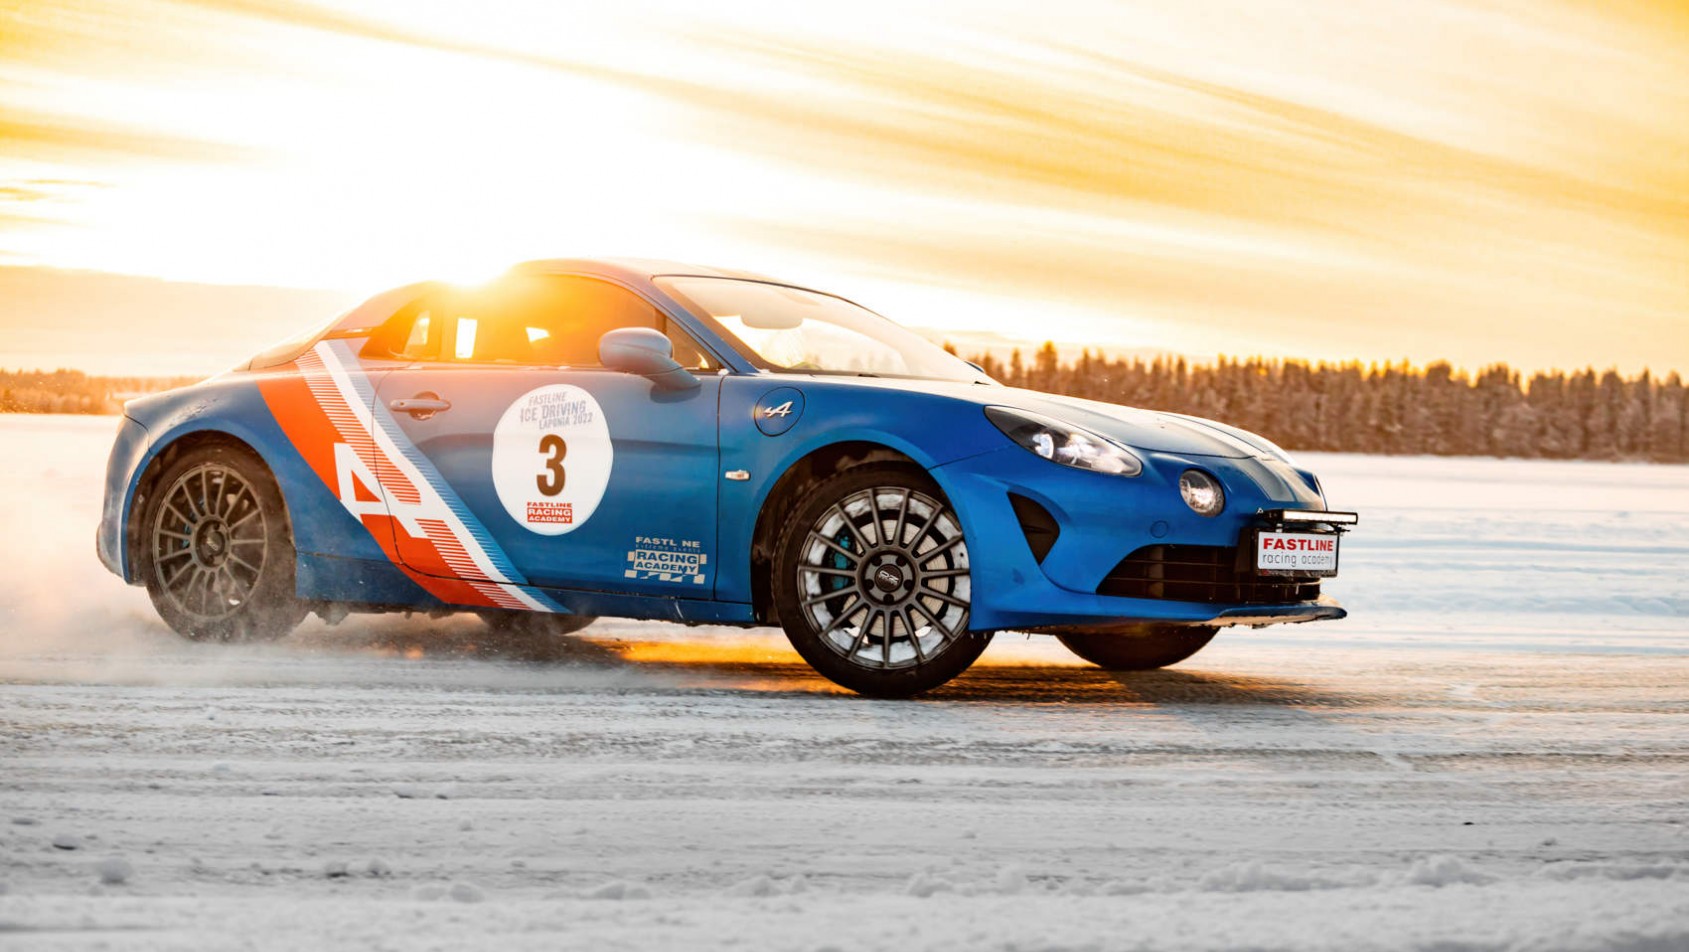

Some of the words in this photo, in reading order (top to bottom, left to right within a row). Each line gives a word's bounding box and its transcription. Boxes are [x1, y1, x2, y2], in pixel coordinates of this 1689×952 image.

[528, 391, 567, 406] FASTLINE
[520, 407, 537, 422] ICE
[541, 400, 586, 419] DRIVING
[539, 416, 570, 430] LAPONIA
[573, 412, 593, 425] 2022
[536, 433, 567, 497] 3
[527, 501, 572, 509] FASTLINE
[528, 508, 571, 517] RACING
[528, 515, 571, 523] ACADEMY
[1263, 538, 1333, 551] FASTLINE
[636, 551, 698, 564] RACING
[1262, 551, 1297, 567] racing
[635, 561, 697, 573] ACADEMY
